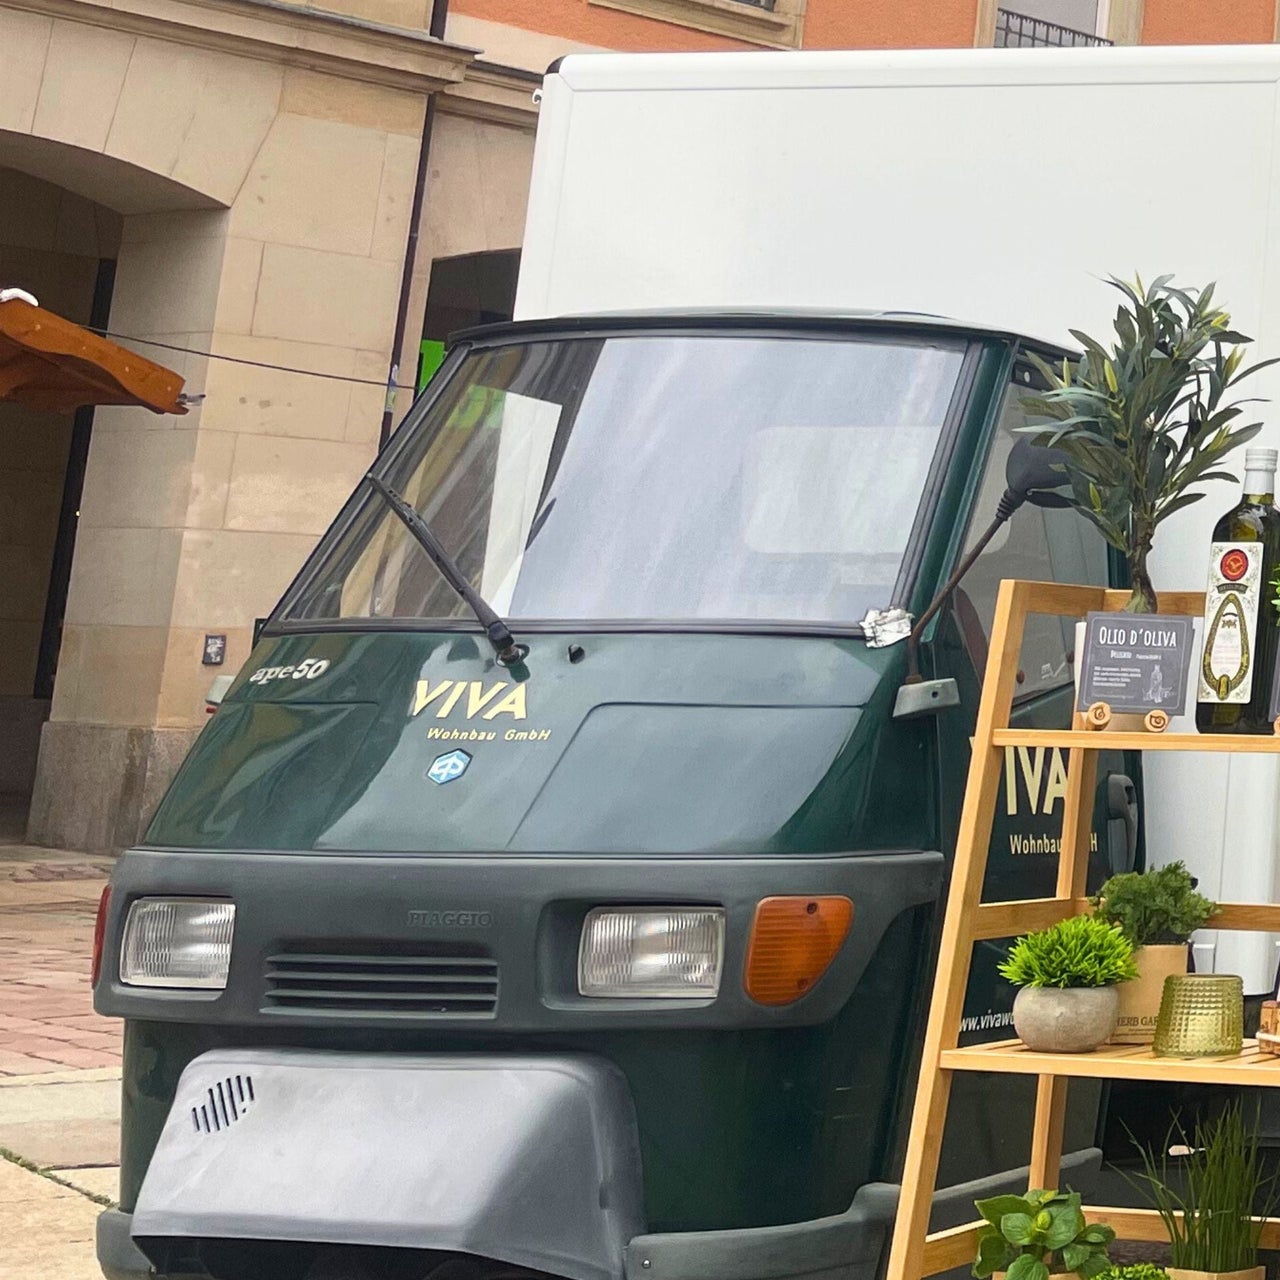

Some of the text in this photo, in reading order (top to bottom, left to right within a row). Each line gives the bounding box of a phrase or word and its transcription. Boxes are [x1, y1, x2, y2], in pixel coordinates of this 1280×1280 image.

[1099, 626, 1126, 646] OLIO
[412, 679, 528, 721] VIVA
[426, 727, 551, 741] Wohnbau GmbH
[1009, 833, 1062, 855] Wohnbau
[406, 910, 492, 927] PIAGGIO
